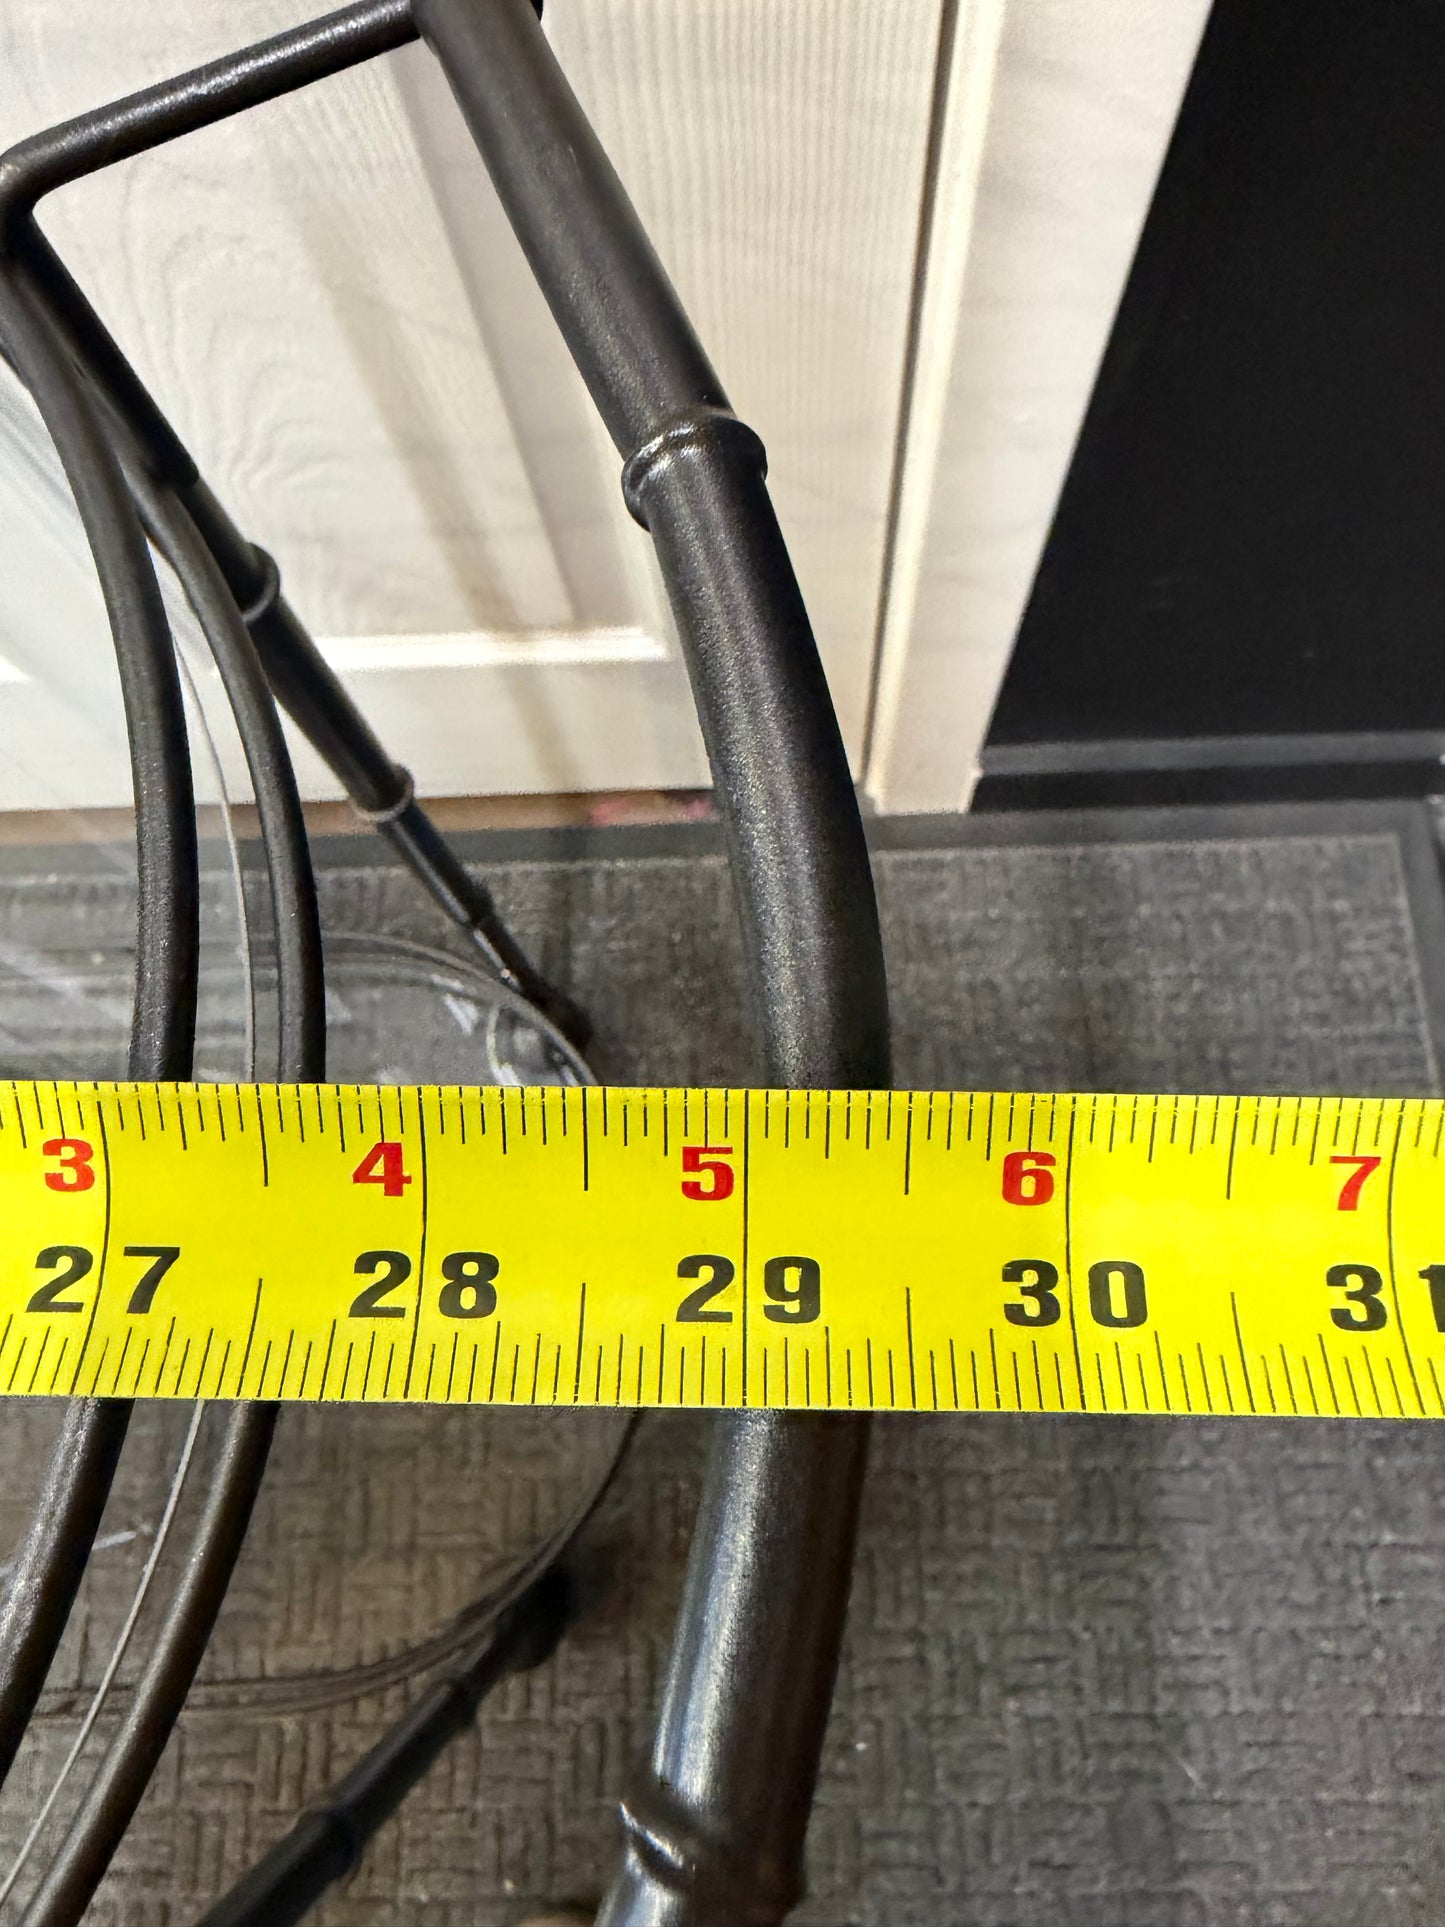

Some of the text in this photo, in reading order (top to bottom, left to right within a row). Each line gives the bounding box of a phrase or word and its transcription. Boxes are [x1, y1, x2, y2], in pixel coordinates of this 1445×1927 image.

[42, 1137, 1382, 1211] 3 4 5 6 7
[25, 1245, 181, 1314] 27
[348, 1250, 500, 1319] 28
[675, 1254, 821, 1324] 29
[1002, 1259, 1148, 1328] 30
